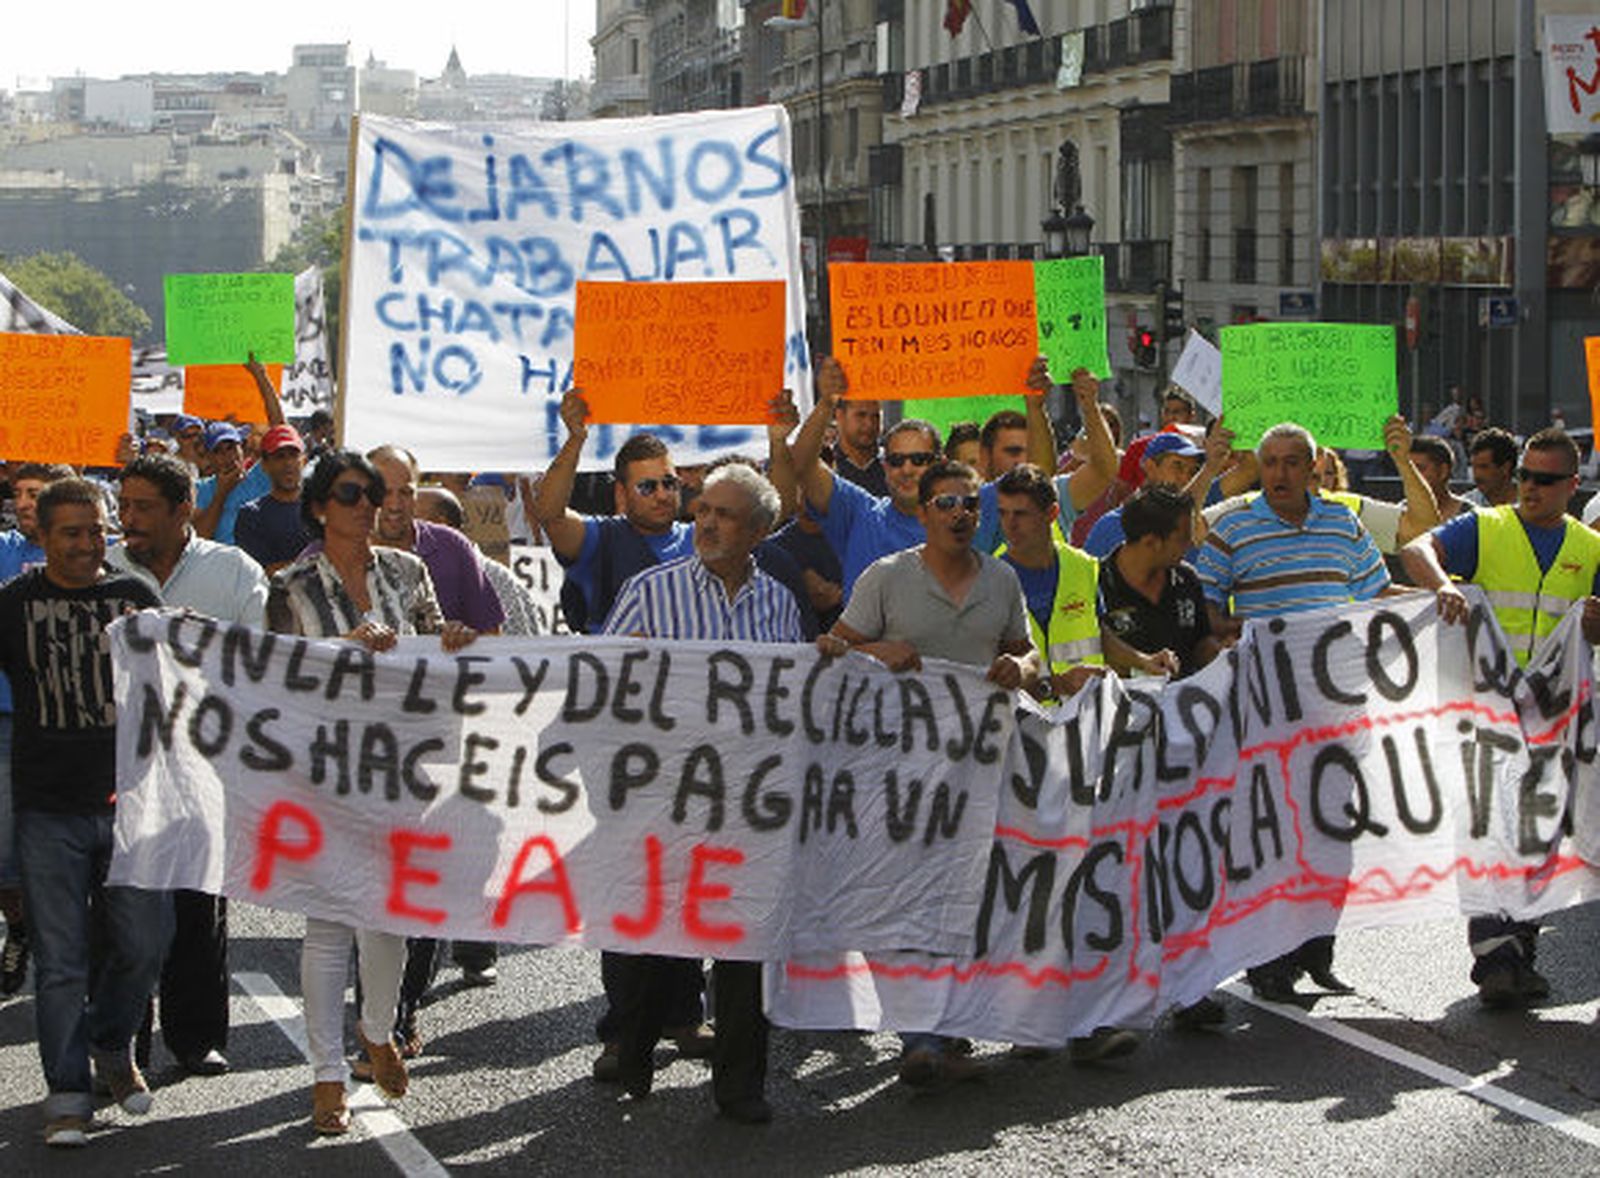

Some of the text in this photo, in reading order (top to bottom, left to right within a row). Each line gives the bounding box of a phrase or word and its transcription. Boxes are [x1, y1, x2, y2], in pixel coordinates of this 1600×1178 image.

[358, 208, 778, 298] TRABAJAR
[285, 638, 375, 702] LA
[402, 656, 551, 717] LEY
[560, 649, 676, 730] DEL
[136, 681, 294, 772] NOS
[308, 718, 581, 814] HACEIS
[608, 742, 859, 845] PAGAR
[249, 800, 747, 942] PEAJE
